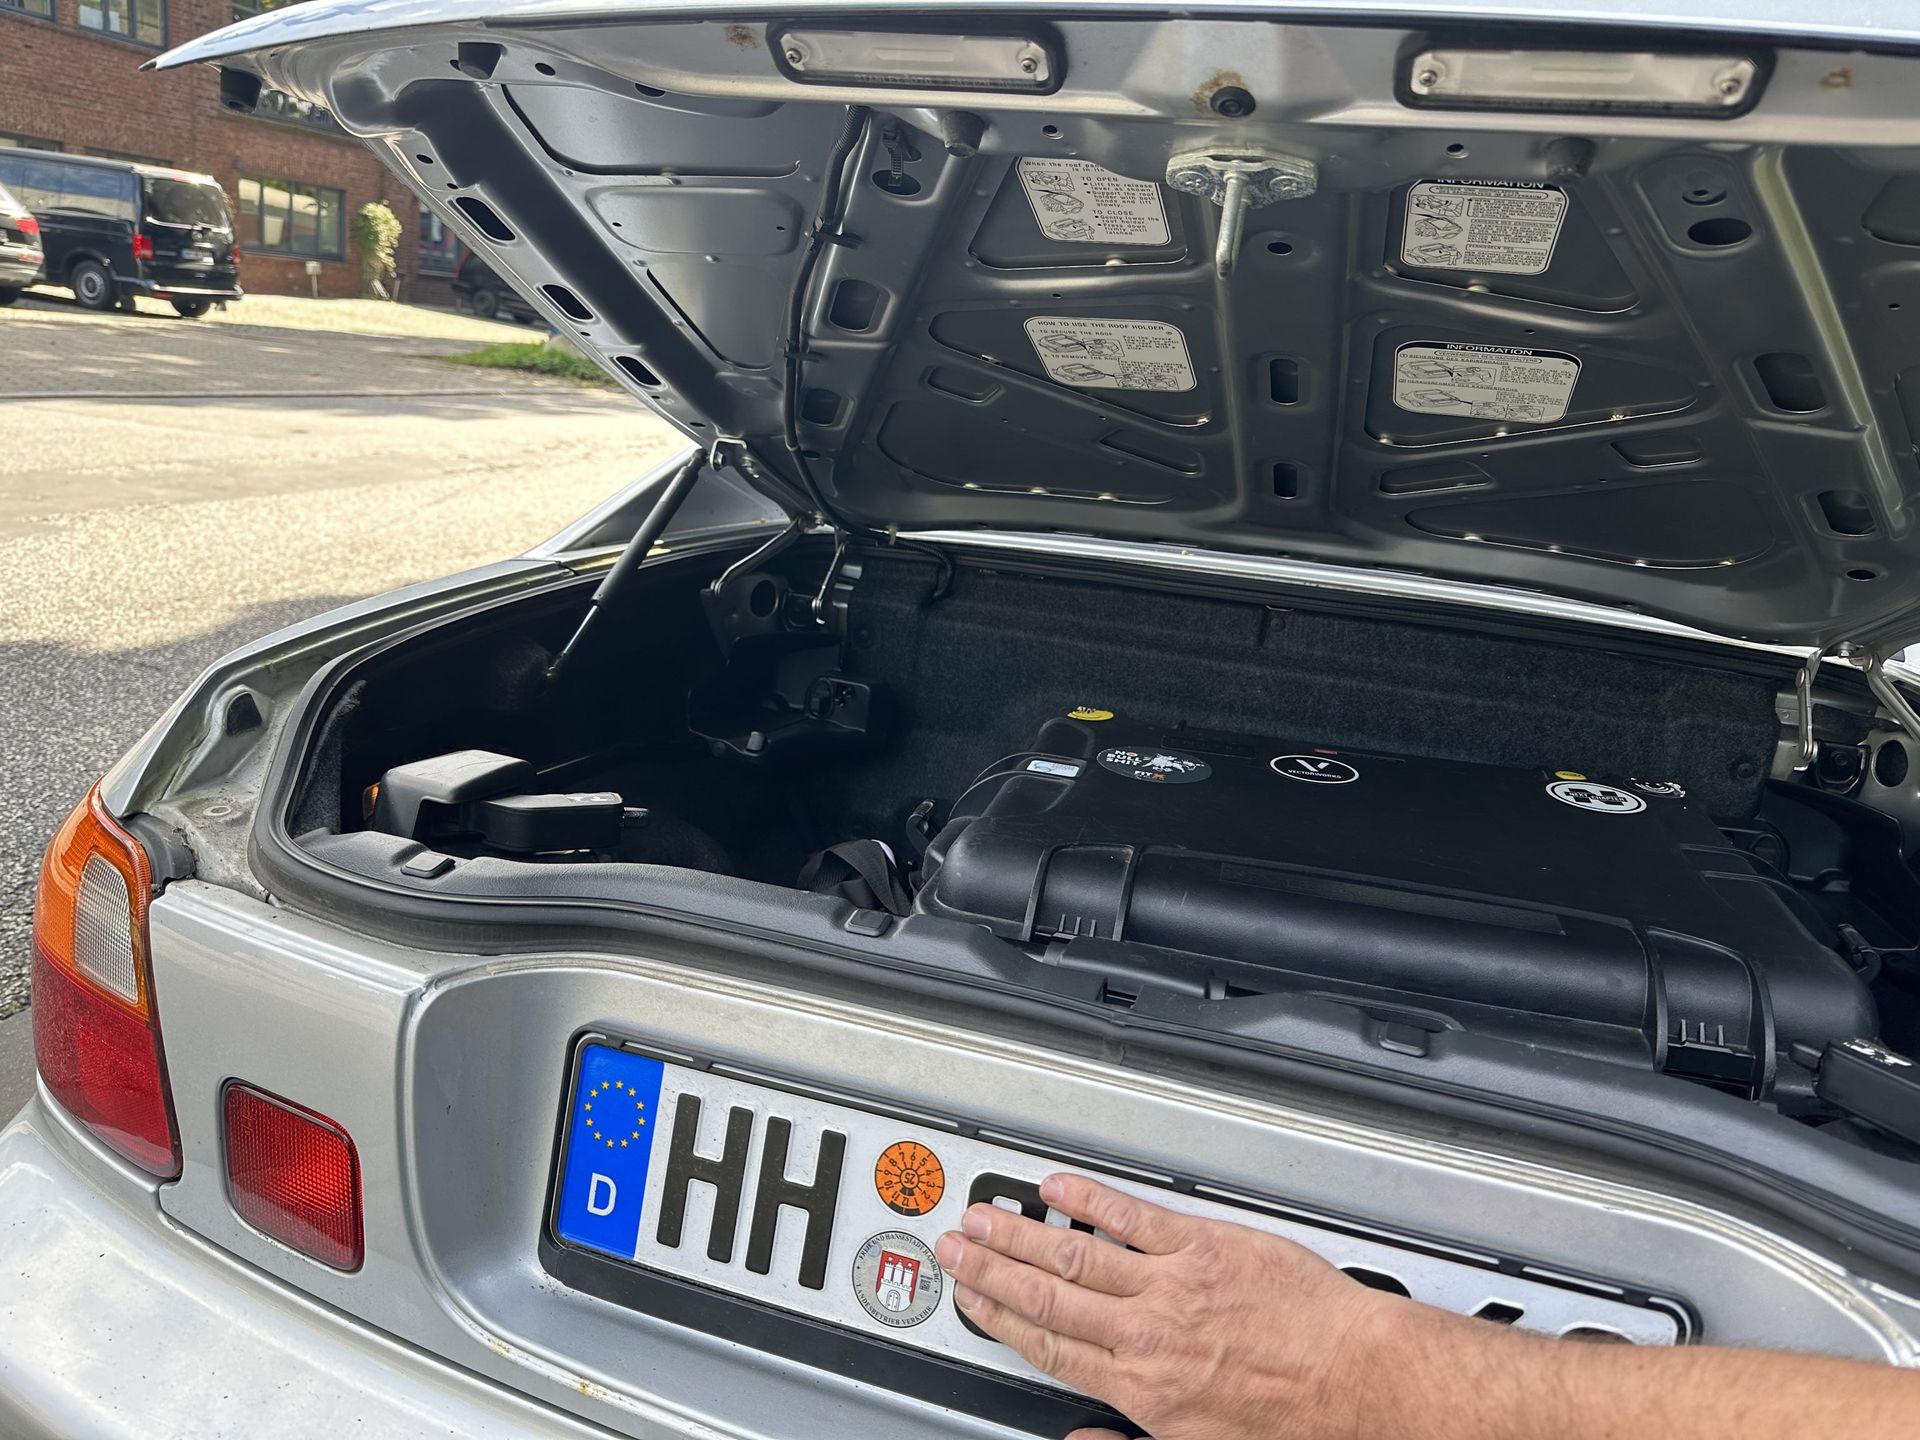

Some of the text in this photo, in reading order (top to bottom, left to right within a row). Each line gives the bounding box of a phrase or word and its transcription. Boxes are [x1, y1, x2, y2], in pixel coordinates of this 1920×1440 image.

[1446, 344, 1533, 356] INFORMATION
[1106, 757, 1140, 766] SHIT
[1288, 769, 1342, 779] VECTORWORKS
[899, 1151, 905, 1161] 7
[910, 1151, 916, 1161] 6
[889, 1157, 898, 1167] 8
[919, 1157, 928, 1167] 5
[904, 1172, 916, 1185] 25
[884, 1180, 894, 1191] 10
[587, 1173, 617, 1217] D
[656, 1093, 847, 1290] HH
[891, 1190, 901, 1202] 11
[921, 1190, 931, 1200] 2
[901, 1196, 910, 1207] 12
[858, 1233, 940, 1283] FREIE UND HANSESTADT HAMBURG
[855, 1283, 933, 1326] LANDESBETRIEB VERKEHR
